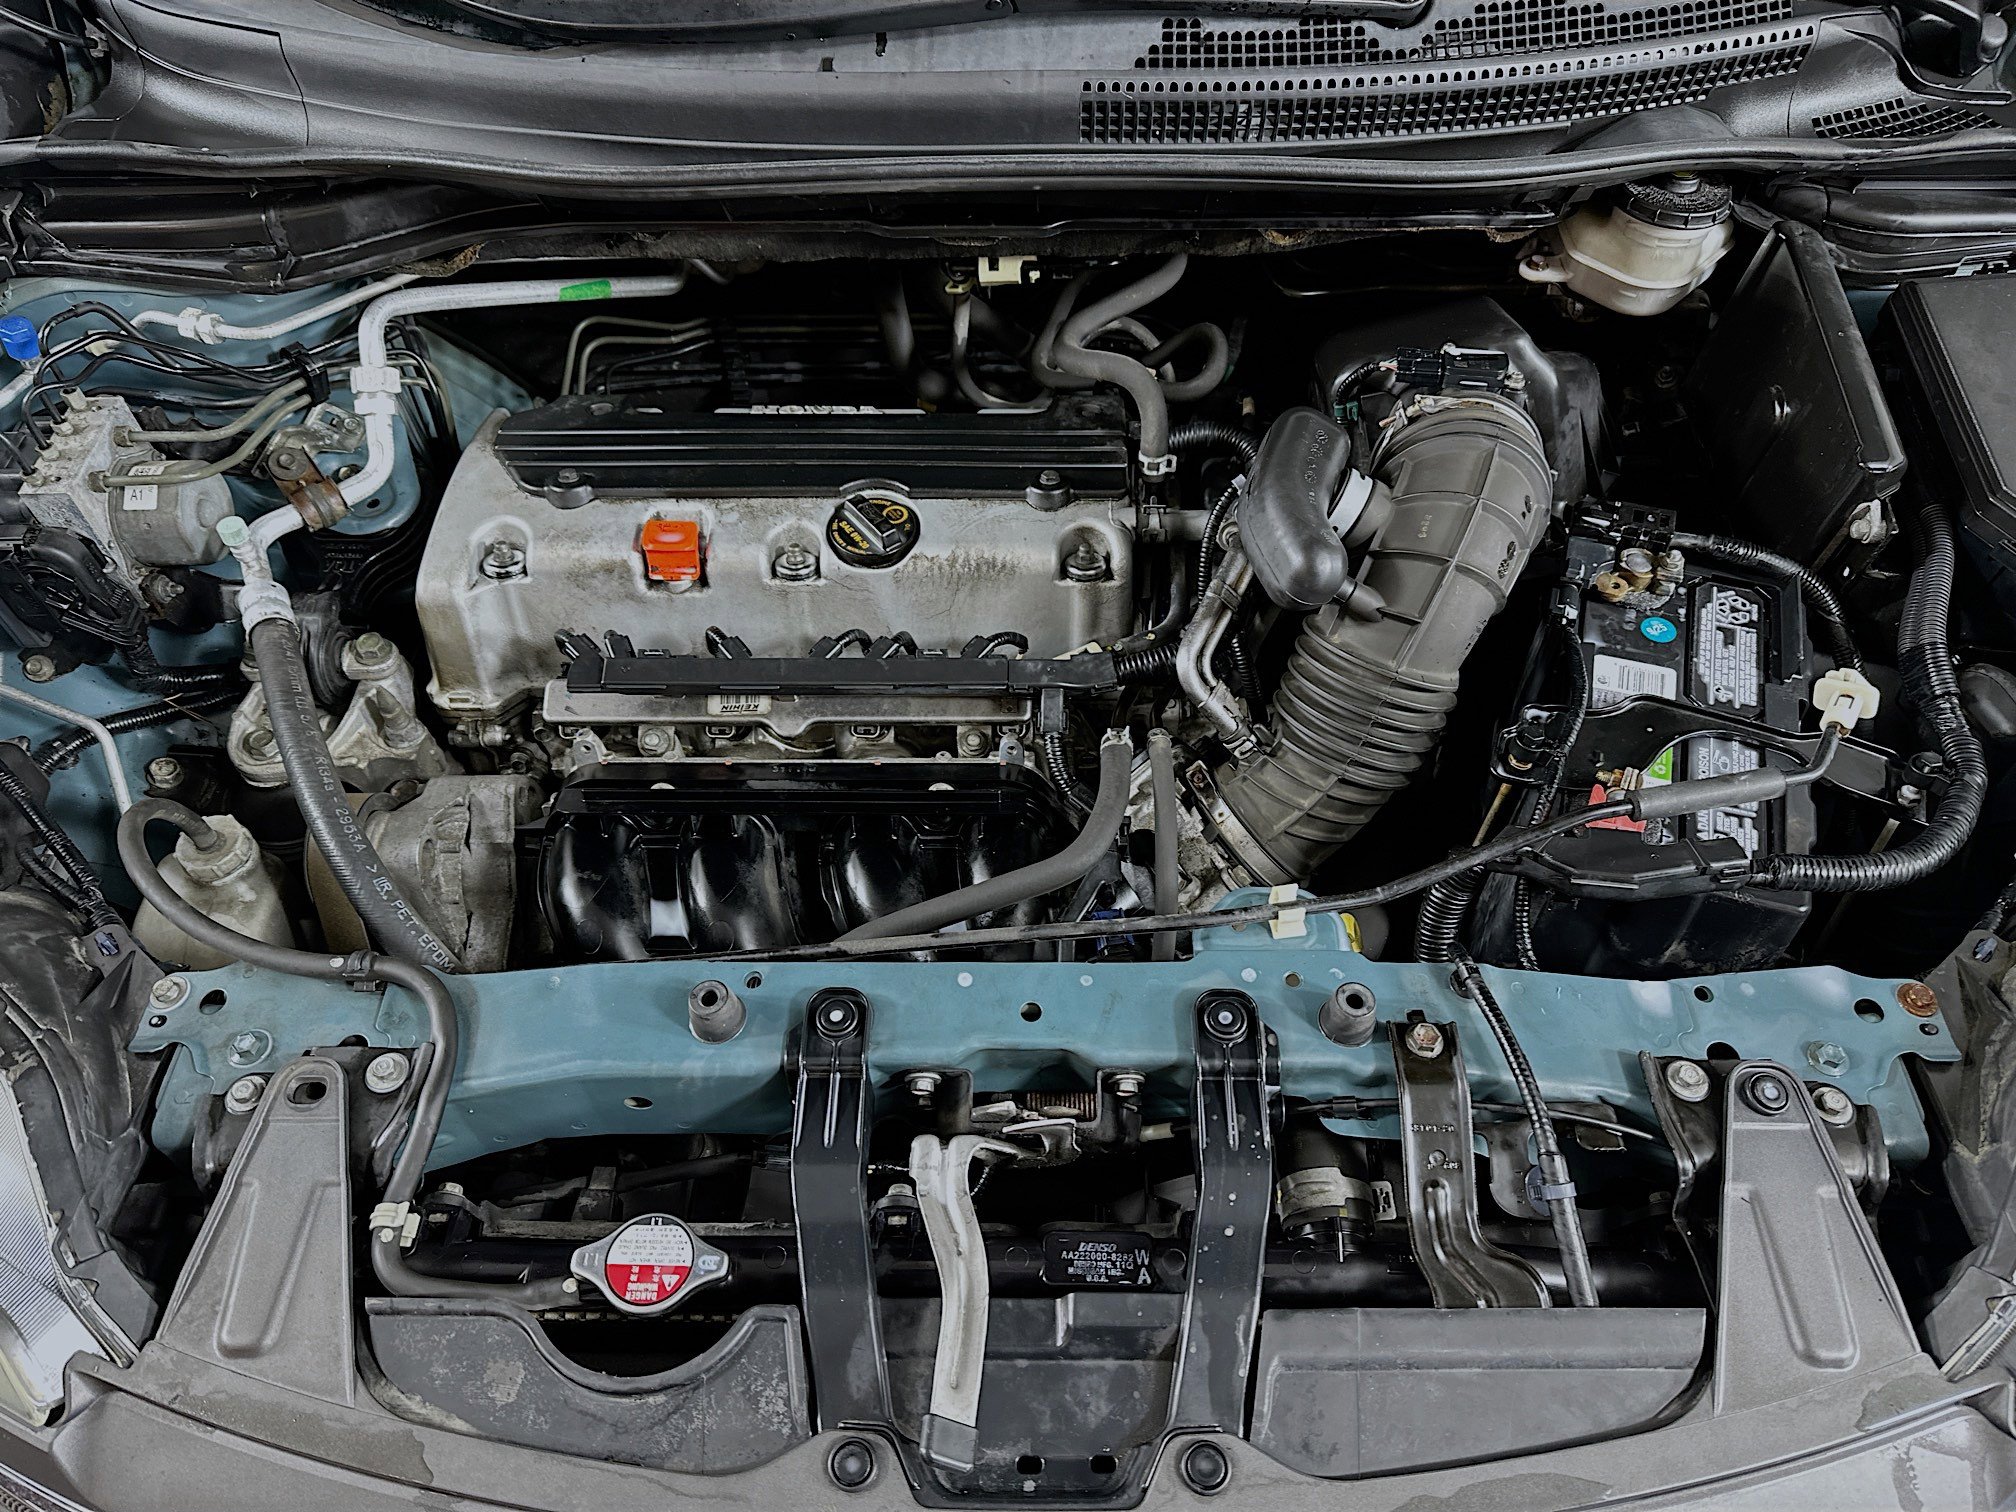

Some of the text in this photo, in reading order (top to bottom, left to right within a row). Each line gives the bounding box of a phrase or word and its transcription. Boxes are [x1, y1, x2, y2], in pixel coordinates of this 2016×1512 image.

[750, 405, 883, 414] HONDA
[130, 489, 143, 501] A1
[839, 521, 870, 549] SAE 0W-20
[721, 704, 760, 713] KEIHIN
[1697, 810, 1709, 833] DAN
[418, 934, 456, 973] EPDM
[1078, 1242, 1118, 1252] DENSO
[1134, 1249, 1150, 1265] W
[1137, 1267, 1152, 1285] A
[625, 1291, 658, 1301] DANGER
